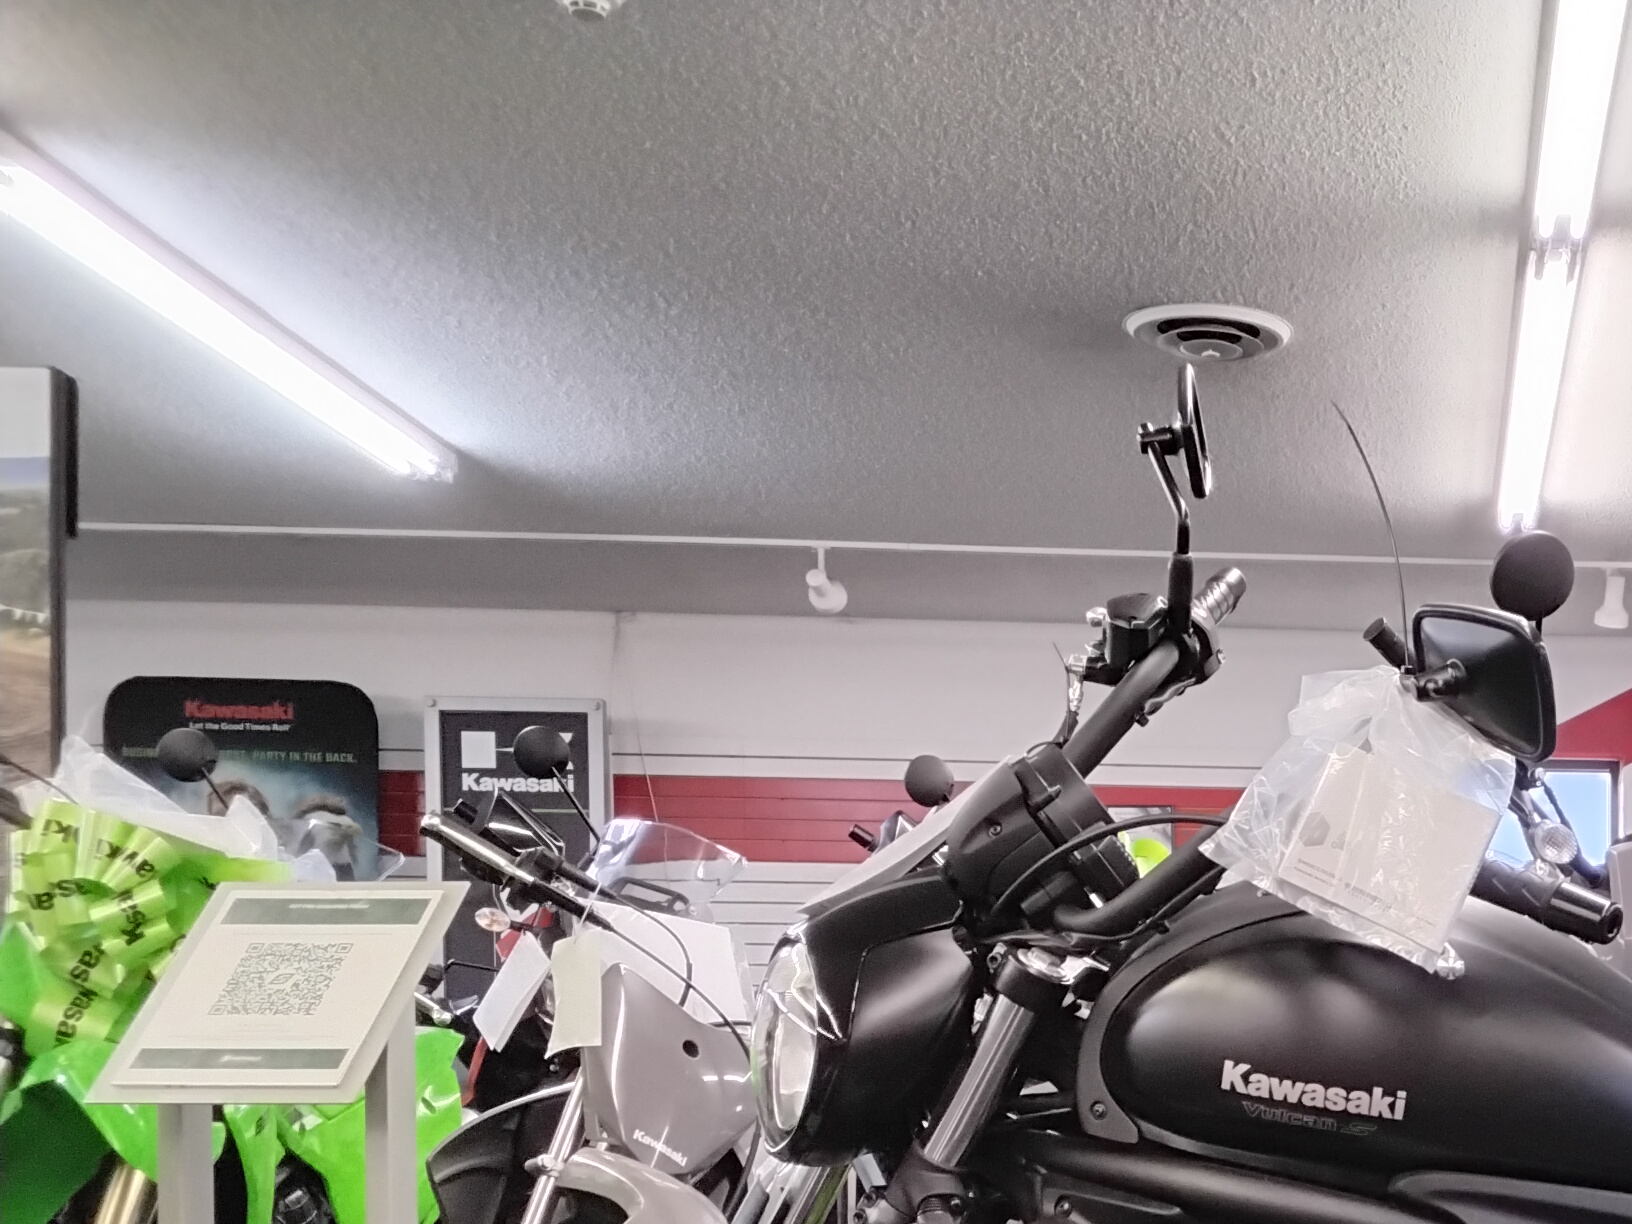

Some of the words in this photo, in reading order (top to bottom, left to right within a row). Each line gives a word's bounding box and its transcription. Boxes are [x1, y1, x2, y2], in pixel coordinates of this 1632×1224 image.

[184, 699, 294, 719] Kawasaki
[252, 750, 286, 761] PARTY
[289, 751, 300, 761] IN
[303, 752, 323, 763] THE
[461, 772, 575, 793] Kawasaki
[1220, 1059, 1408, 1121] Kawasaki
[633, 1128, 688, 1167] Kawasaki
